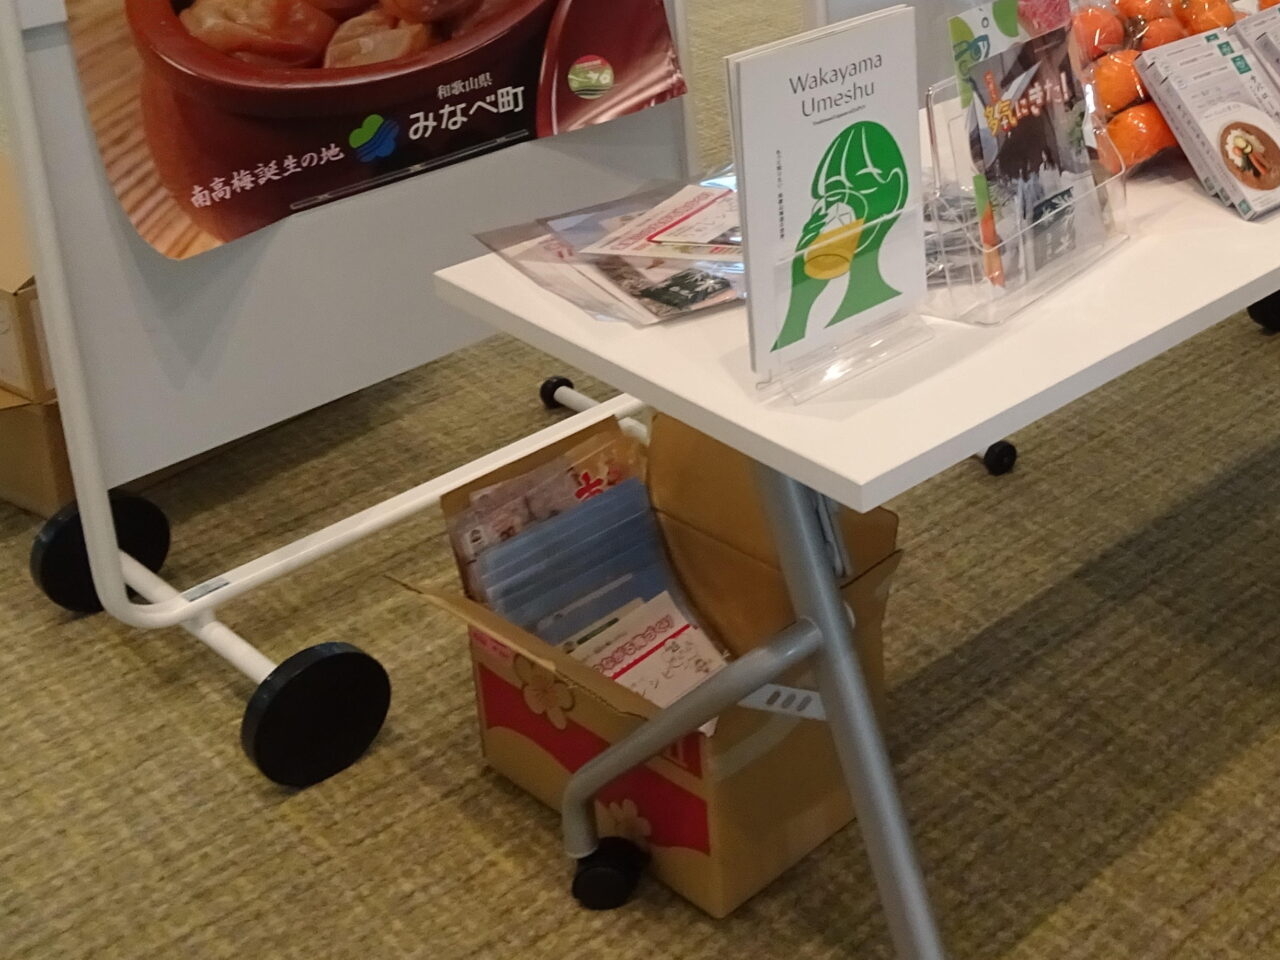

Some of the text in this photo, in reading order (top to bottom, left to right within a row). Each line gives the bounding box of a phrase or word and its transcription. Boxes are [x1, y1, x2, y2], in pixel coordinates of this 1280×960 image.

[437, 72, 493, 101] 和歌山県
[789, 54, 883, 95] Wakayama
[408, 85, 526, 141] みなべ町
[801, 82, 875, 117] Umeshu
[190, 142, 345, 209] 南高梅誕生の地
